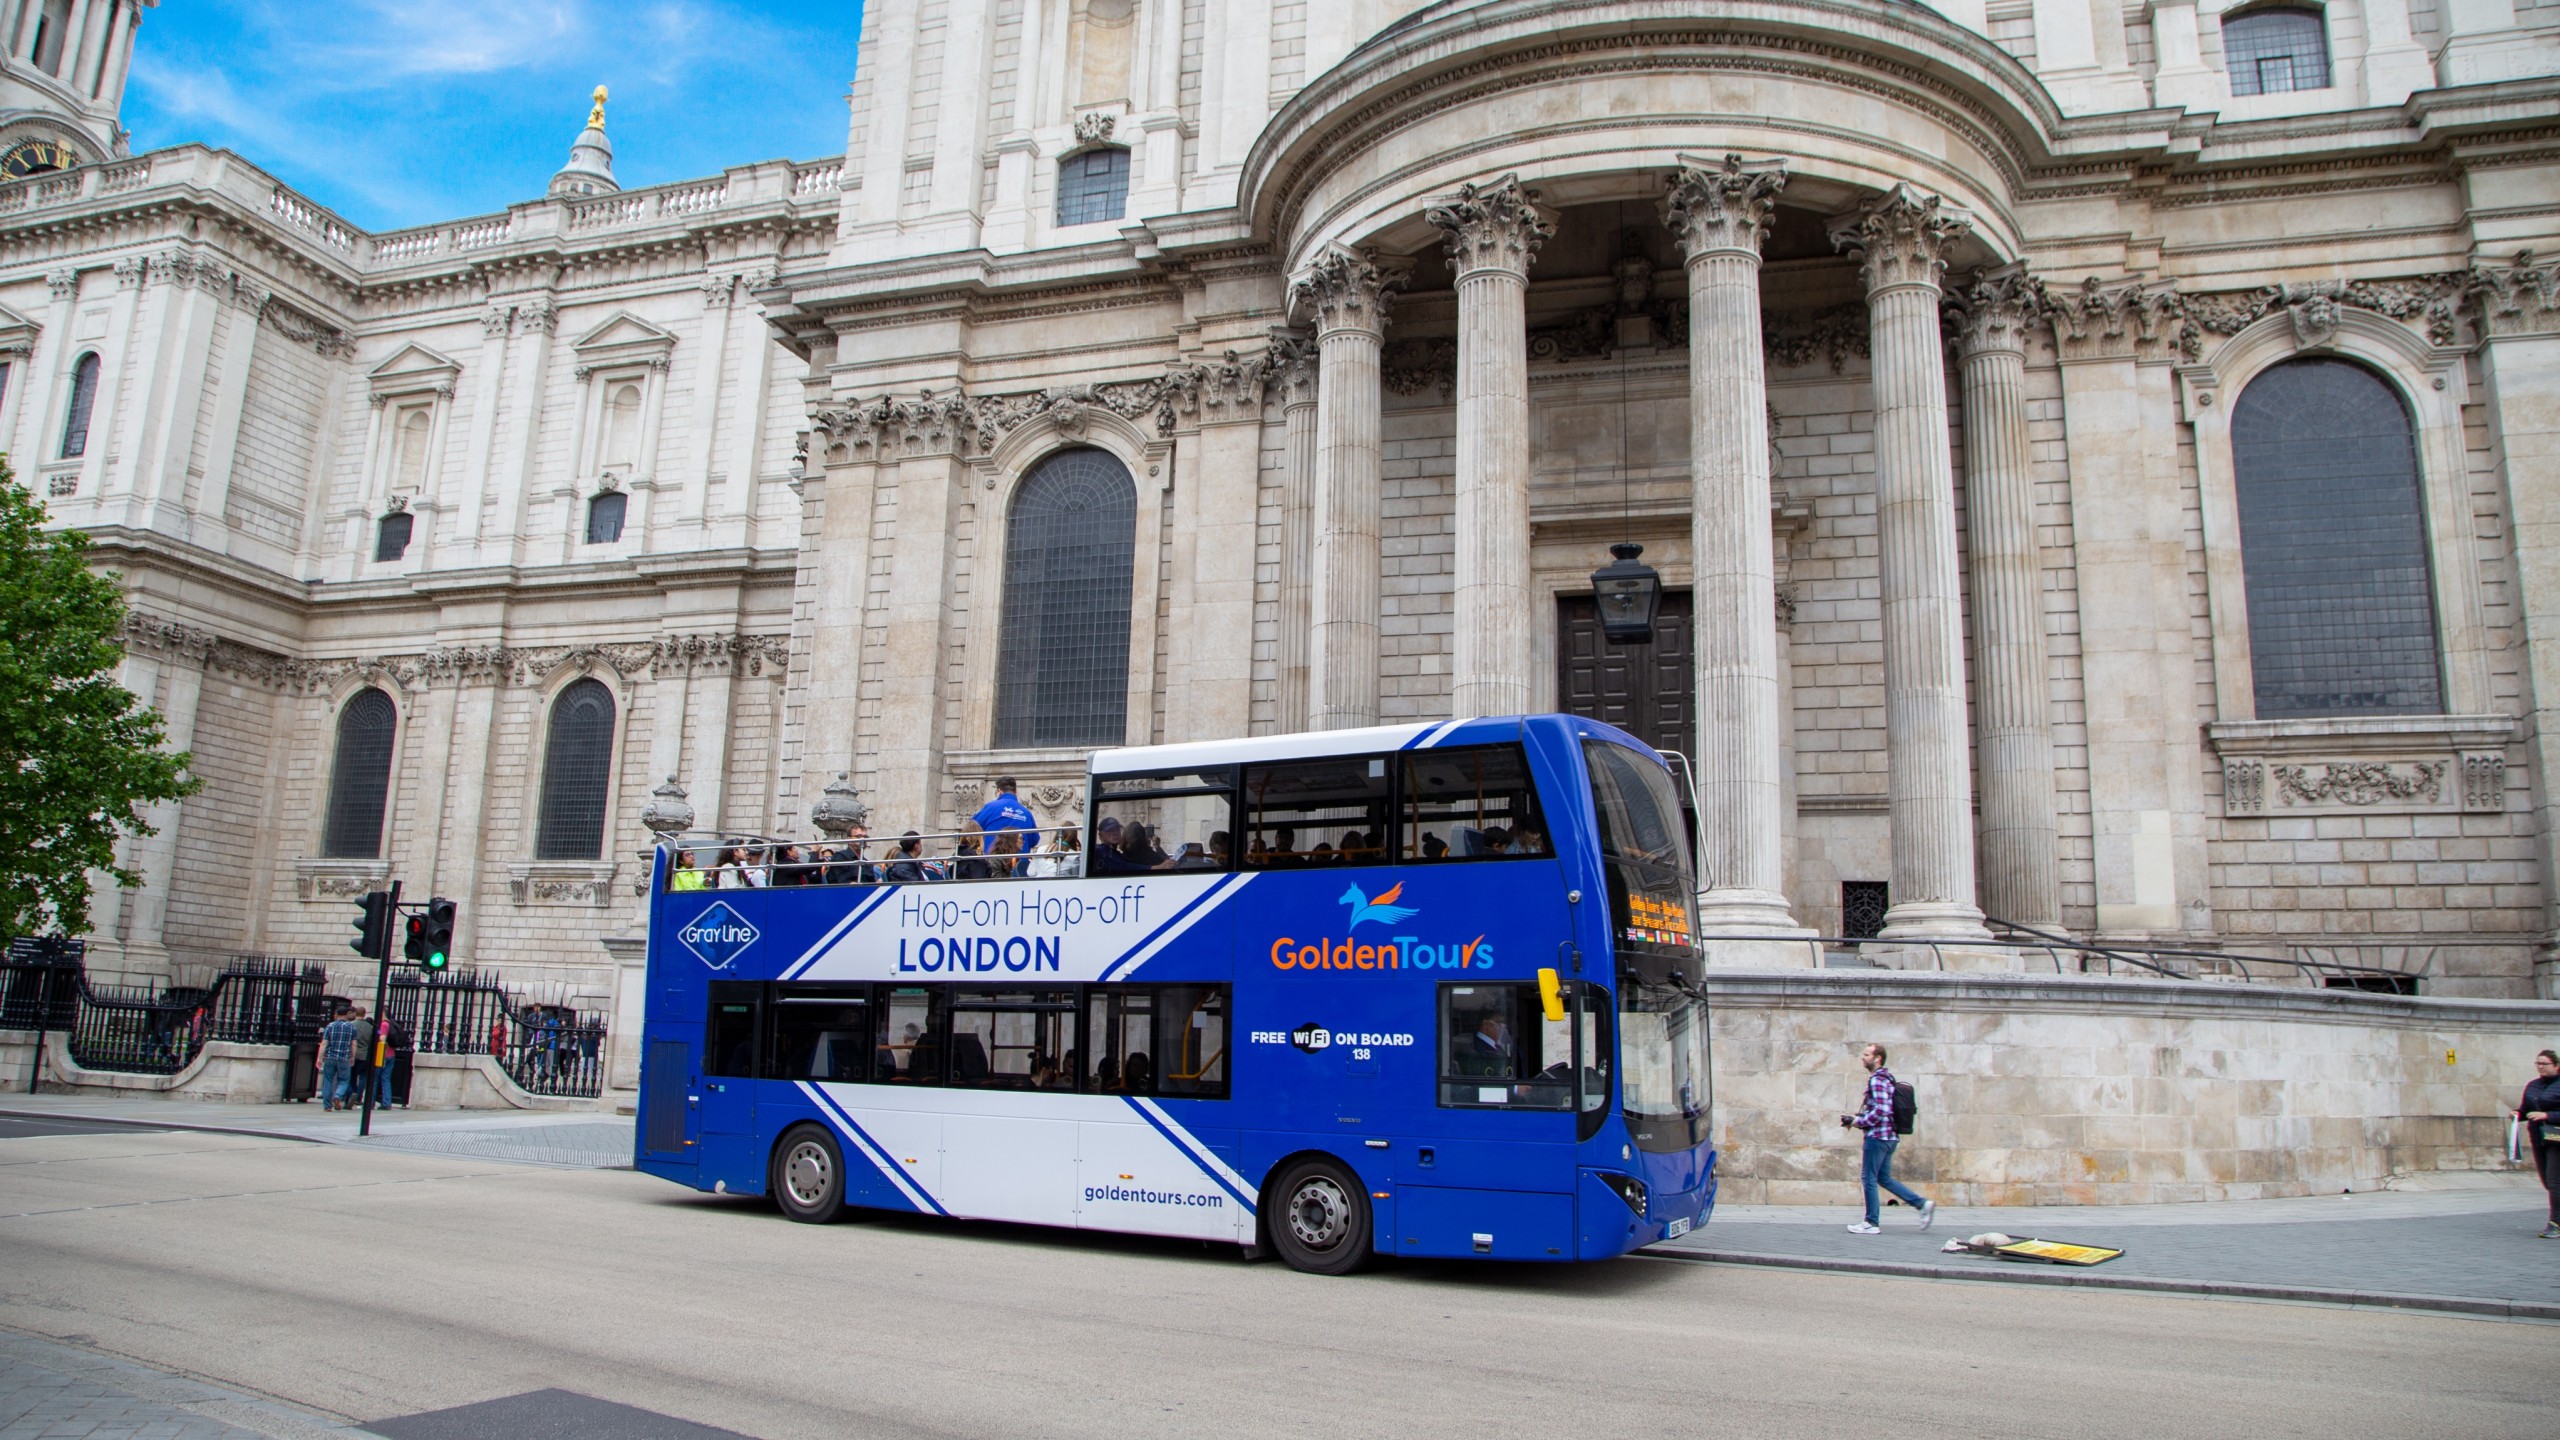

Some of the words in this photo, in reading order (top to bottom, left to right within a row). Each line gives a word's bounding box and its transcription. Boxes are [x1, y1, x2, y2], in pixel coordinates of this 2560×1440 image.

[902, 893, 1009, 934] Hop-on
[1021, 885, 1145, 932] Hop-off
[899, 936, 1060, 972] LONDON
[1251, 1031, 1286, 1044] FREE
[1335, 1033, 1357, 1046] ON
[1361, 1034, 1414, 1046] BOARD
[1352, 1048, 1371, 1060] 138
[1085, 1185, 1222, 1207] goldentours.com
